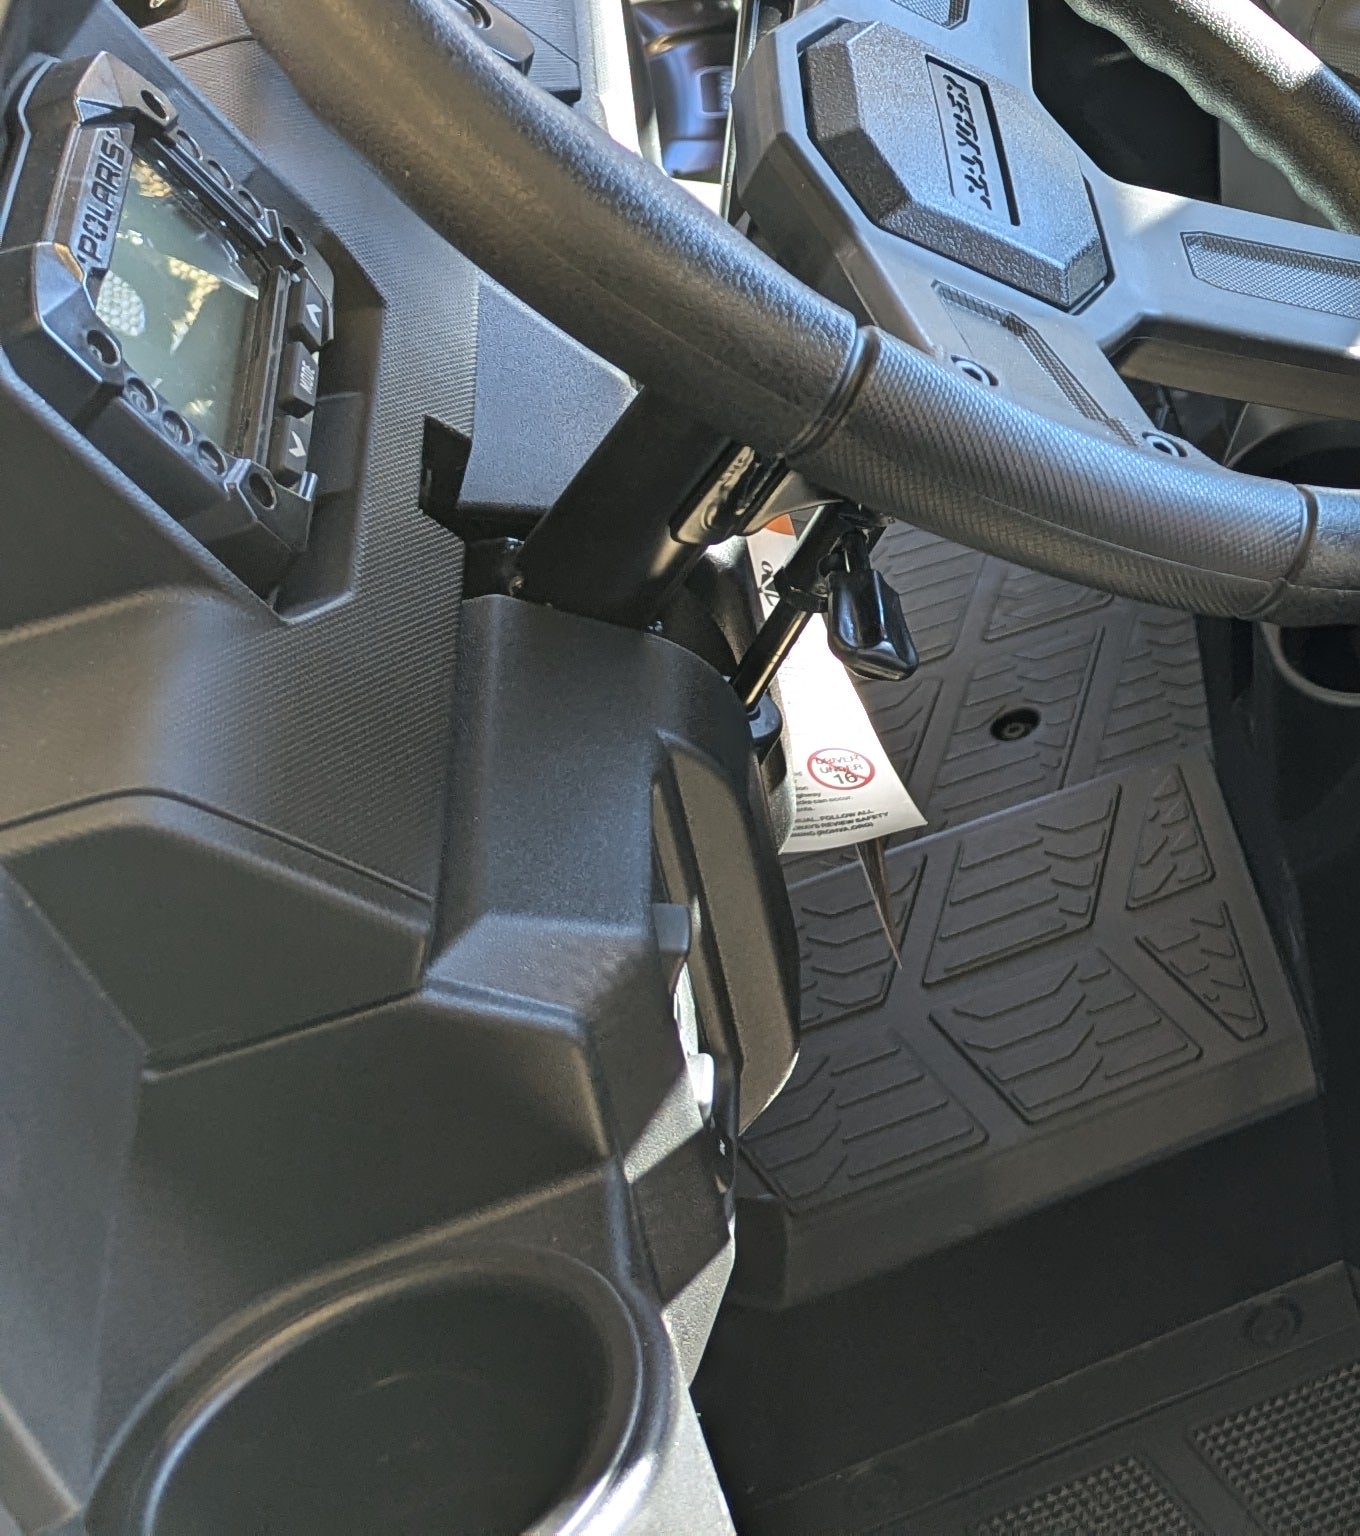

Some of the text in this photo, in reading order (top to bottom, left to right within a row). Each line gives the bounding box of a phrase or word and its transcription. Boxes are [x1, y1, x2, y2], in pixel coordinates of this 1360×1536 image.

[80, 141, 126, 263] POLARIS
[298, 360, 317, 395] MODE
[833, 772, 858, 785] 16
[819, 812, 856, 821] FOLLOW
[820, 818, 854, 828] REVIEW
[855, 811, 889, 823] SAFETY
